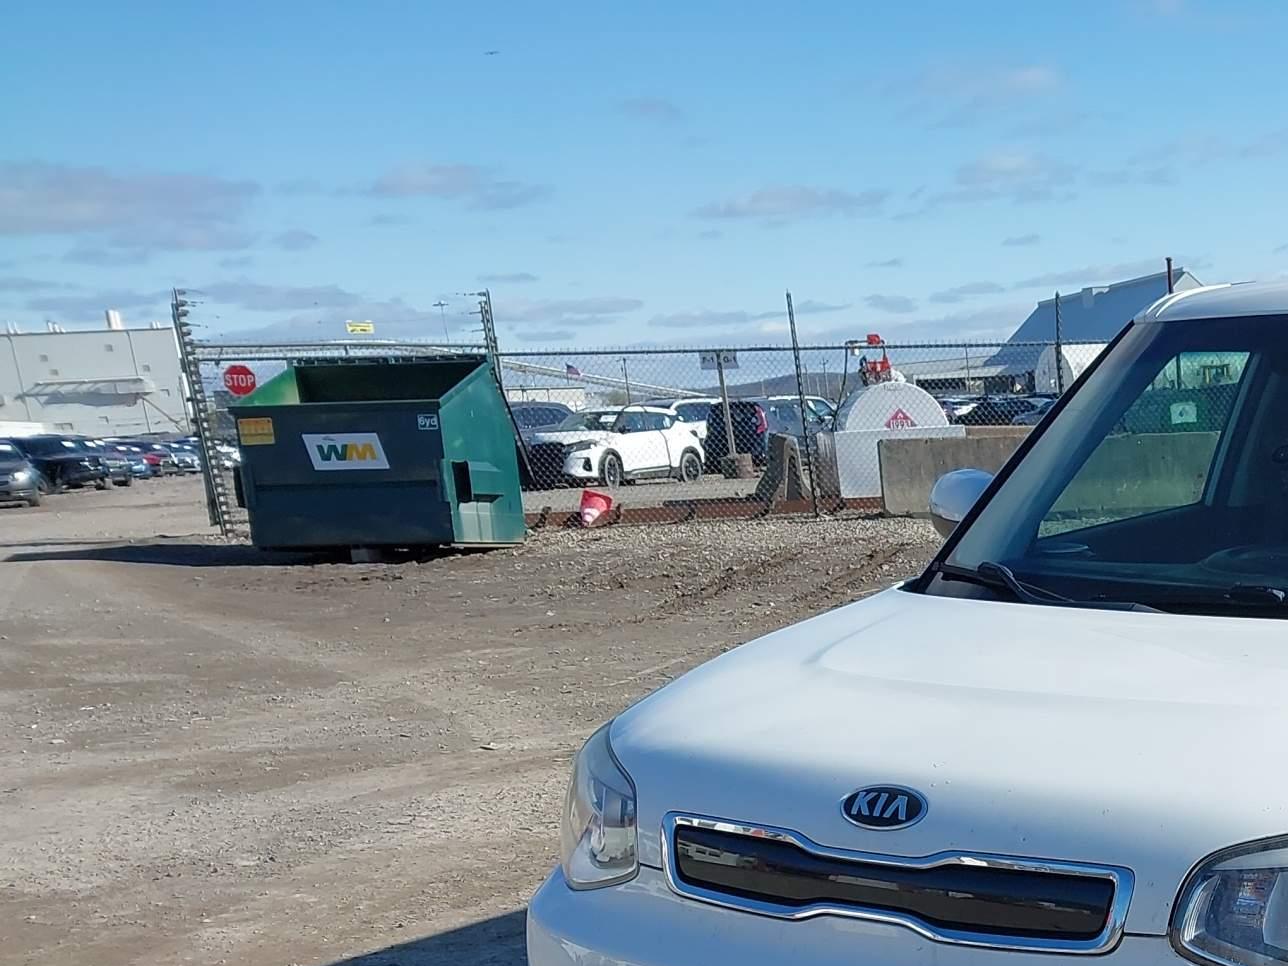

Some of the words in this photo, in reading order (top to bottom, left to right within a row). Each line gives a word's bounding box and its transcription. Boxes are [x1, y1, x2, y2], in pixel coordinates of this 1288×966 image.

[224, 374, 254, 387] STOP
[316, 443, 377, 461] WM
[850, 791, 908, 821] KIA
